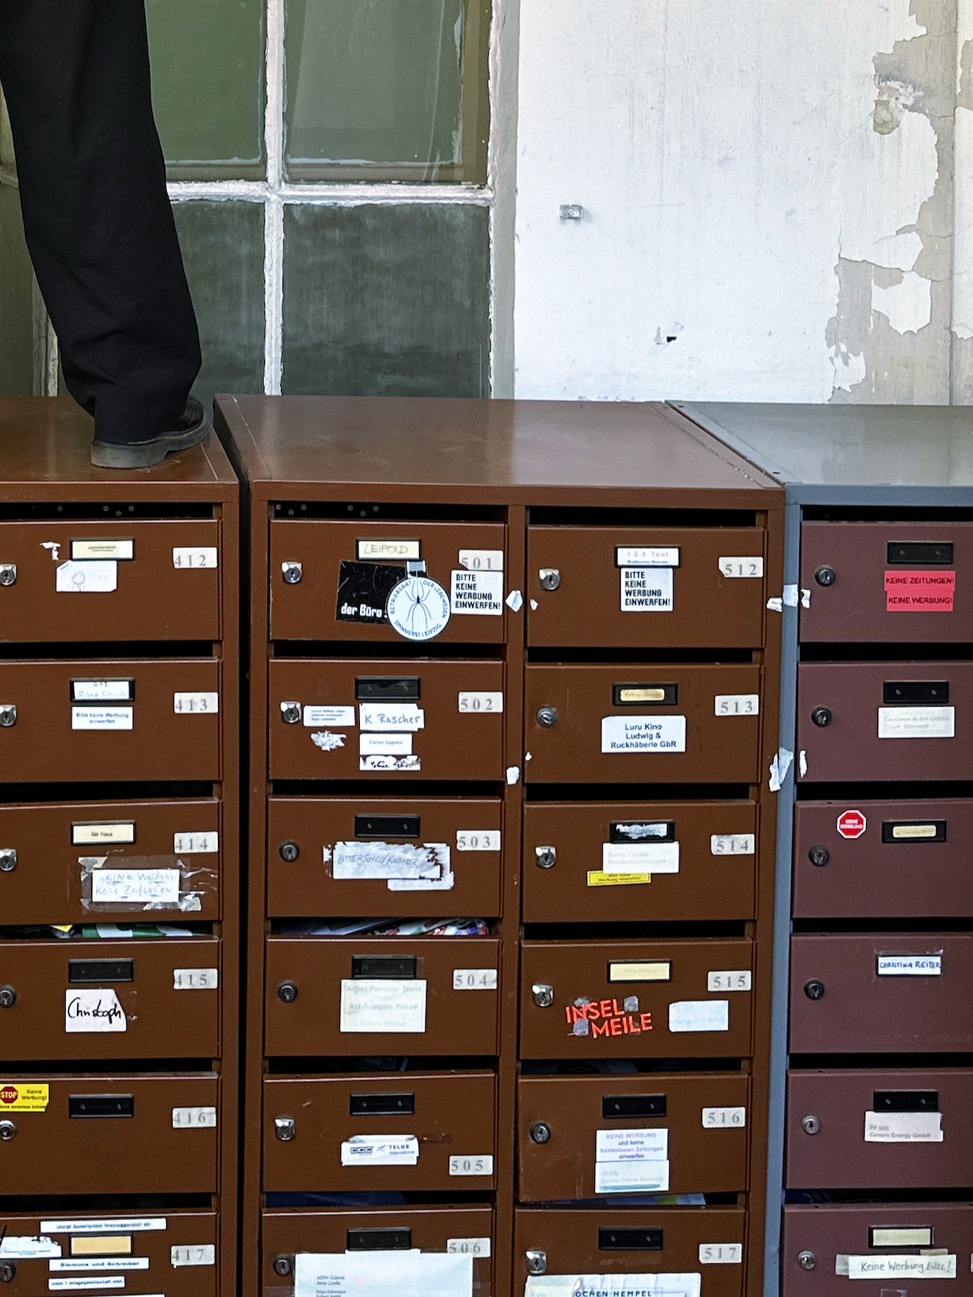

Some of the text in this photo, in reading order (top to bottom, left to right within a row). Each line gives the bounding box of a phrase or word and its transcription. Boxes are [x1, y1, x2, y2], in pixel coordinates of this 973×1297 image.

[174, 554, 207, 567] 412
[461, 557, 492, 570] 501
[624, 571, 645, 579] BITTE
[724, 563, 757, 576] 512
[455, 573, 477, 582] BITTE
[455, 583, 477, 591] KEINE
[624, 580, 646, 588] KEINE
[455, 592, 493, 600] WERBUNG
[624, 589, 662, 597] WERBUNG
[455, 600, 501, 610] EINWERFEN!
[624, 598, 671, 606] EINWERFEN!
[341, 602, 358, 616] der
[421, 623, 442, 637] LEIPZIG
[175, 698, 208, 711] 413
[460, 698, 493, 711] 502
[720, 701, 753, 714] 513
[625, 732, 654, 740] Ludwig
[175, 838, 208, 850] 414
[458, 836, 491, 848] 503
[716, 840, 749, 852] 514
[175, 974, 207, 986] 415
[455, 974, 487, 986] 504
[713, 975, 746, 988] 515
[67, 997, 122, 1024] Christoph
[565, 998, 626, 1023] INSEL
[591, 1012, 653, 1039] MEILE
[0, 1091, 18, 1099] STOP
[174, 1112, 206, 1124] 416
[707, 1111, 740, 1124] 516
[451, 1159, 484, 1172] 505
[448, 1242, 481, 1254] 506
[704, 1247, 737, 1259] 517
[173, 1248, 204, 1261] 417
[860, 1261, 885, 1272] Keine
[888, 1259, 924, 1274] Werbung
